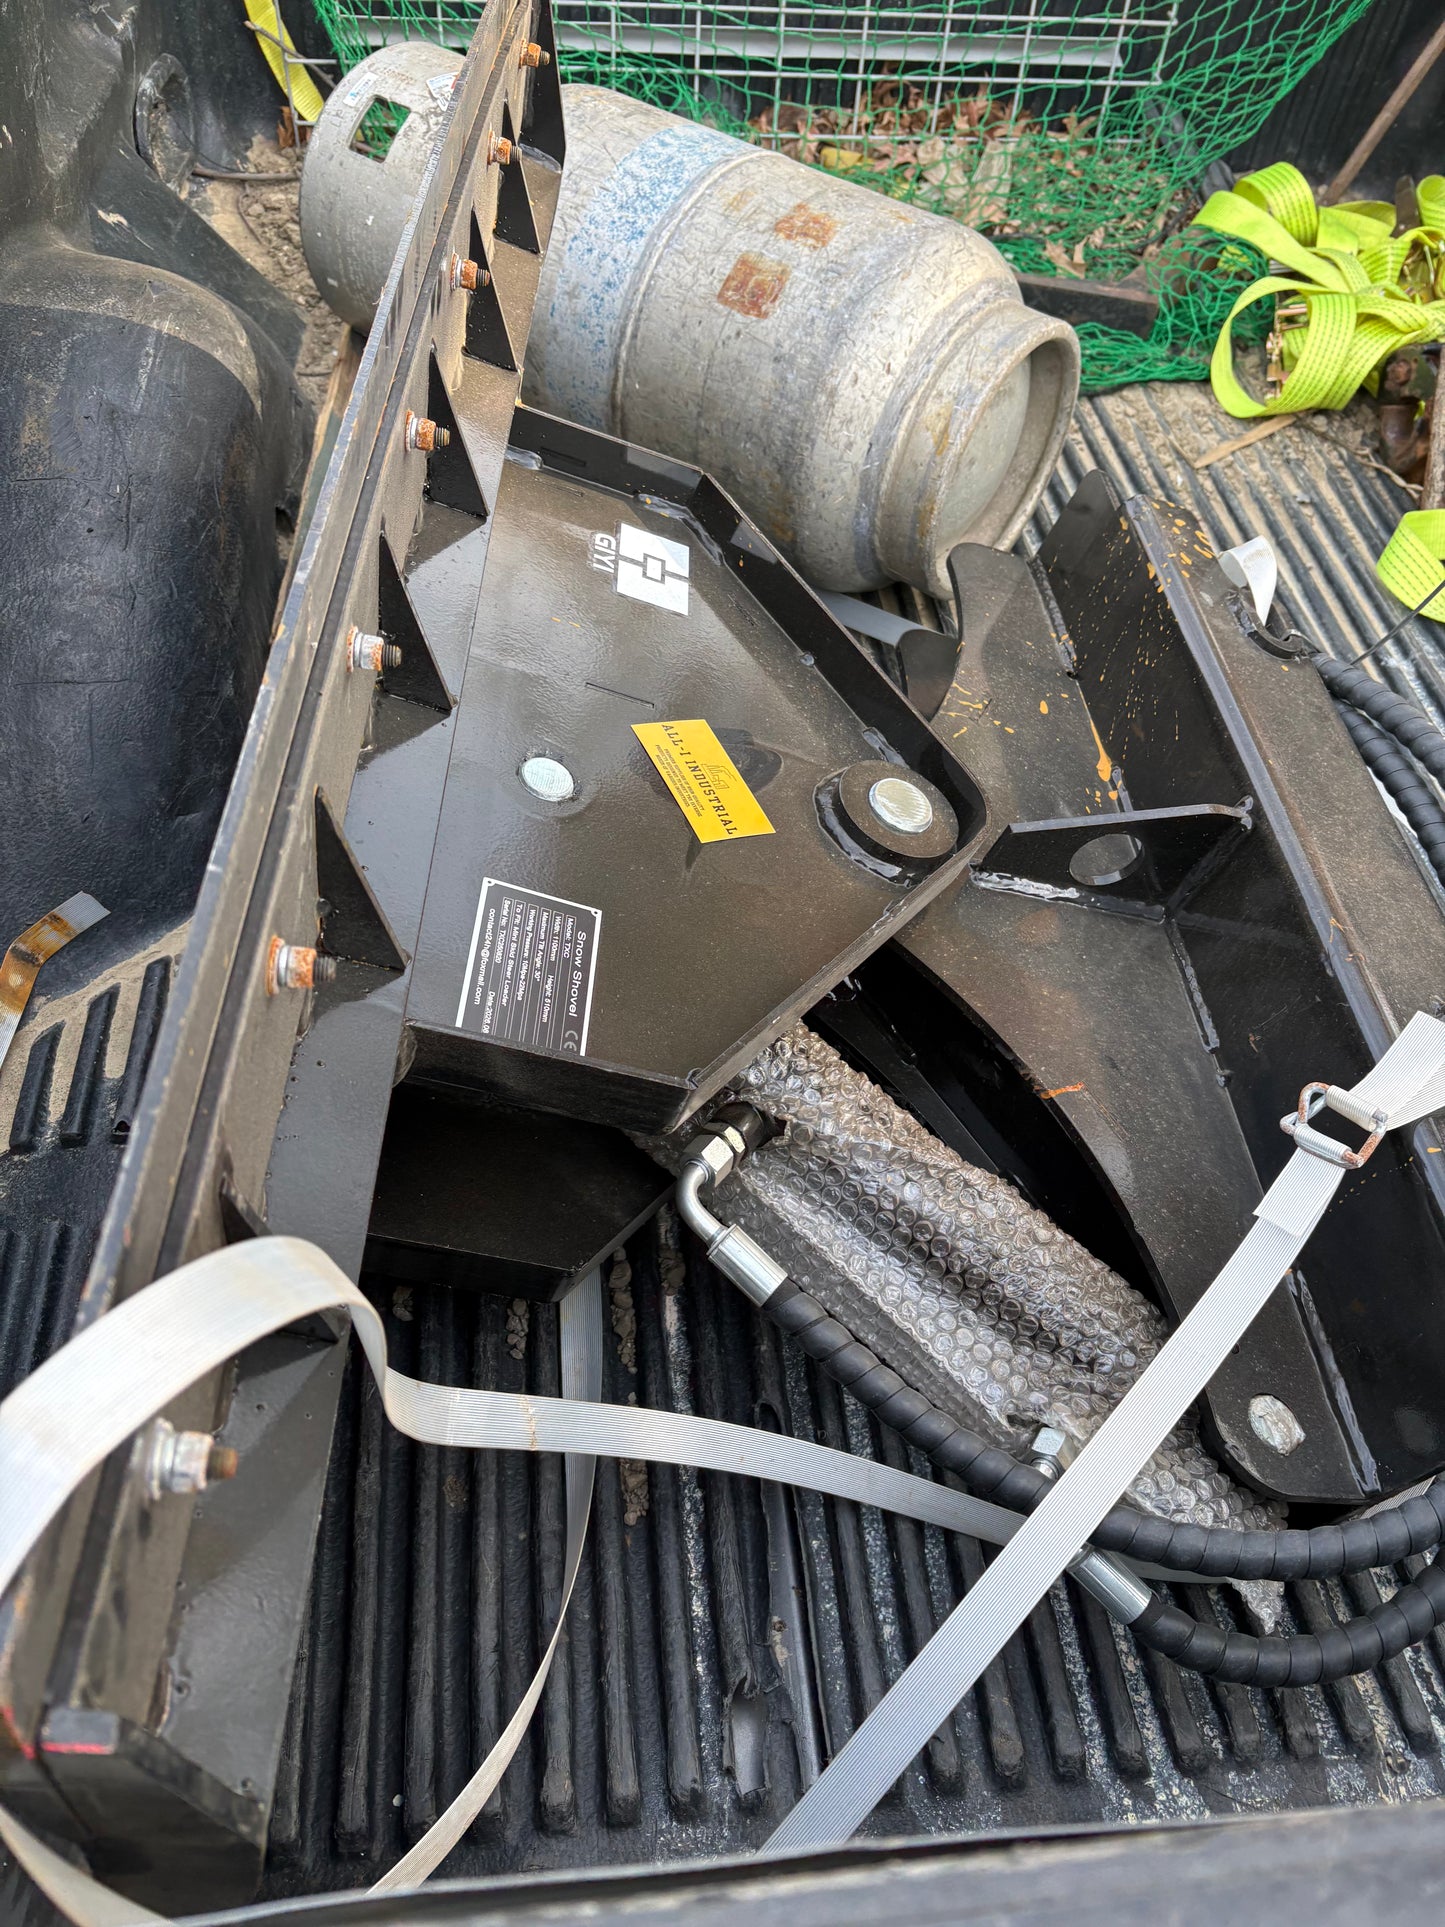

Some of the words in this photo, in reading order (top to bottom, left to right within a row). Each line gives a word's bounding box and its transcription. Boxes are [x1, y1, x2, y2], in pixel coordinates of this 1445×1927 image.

[593, 533, 617, 574] GIYI
[661, 724, 691, 756] ALL-I
[685, 760, 738, 835] INDUSTRIAL
[502, 900, 511, 918] Serial
[516, 903, 523, 913] To
[525, 909, 536, 932] Working
[539, 911, 549, 940] Maximum
[553, 915, 562, 934] Width:
[566, 917, 575, 941] Model:
[511, 927, 520, 942] Mini
[524, 932, 533, 957] Pressure:
[474, 908, 495, 1005] contact24h@foxmail.com
[509, 943, 517, 959] Skid
[535, 949, 544, 969] Angle:
[550, 935, 559, 961] 1100mm
[564, 941, 572, 959] TXC
[576, 931, 586, 968] Snow
[506, 960, 515, 980] Steer
[502, 981, 512, 1006] Loader
[545, 974, 554, 997] Height:
[568, 970, 582, 1017] Shovel
[564, 1030, 578, 1051] CE
